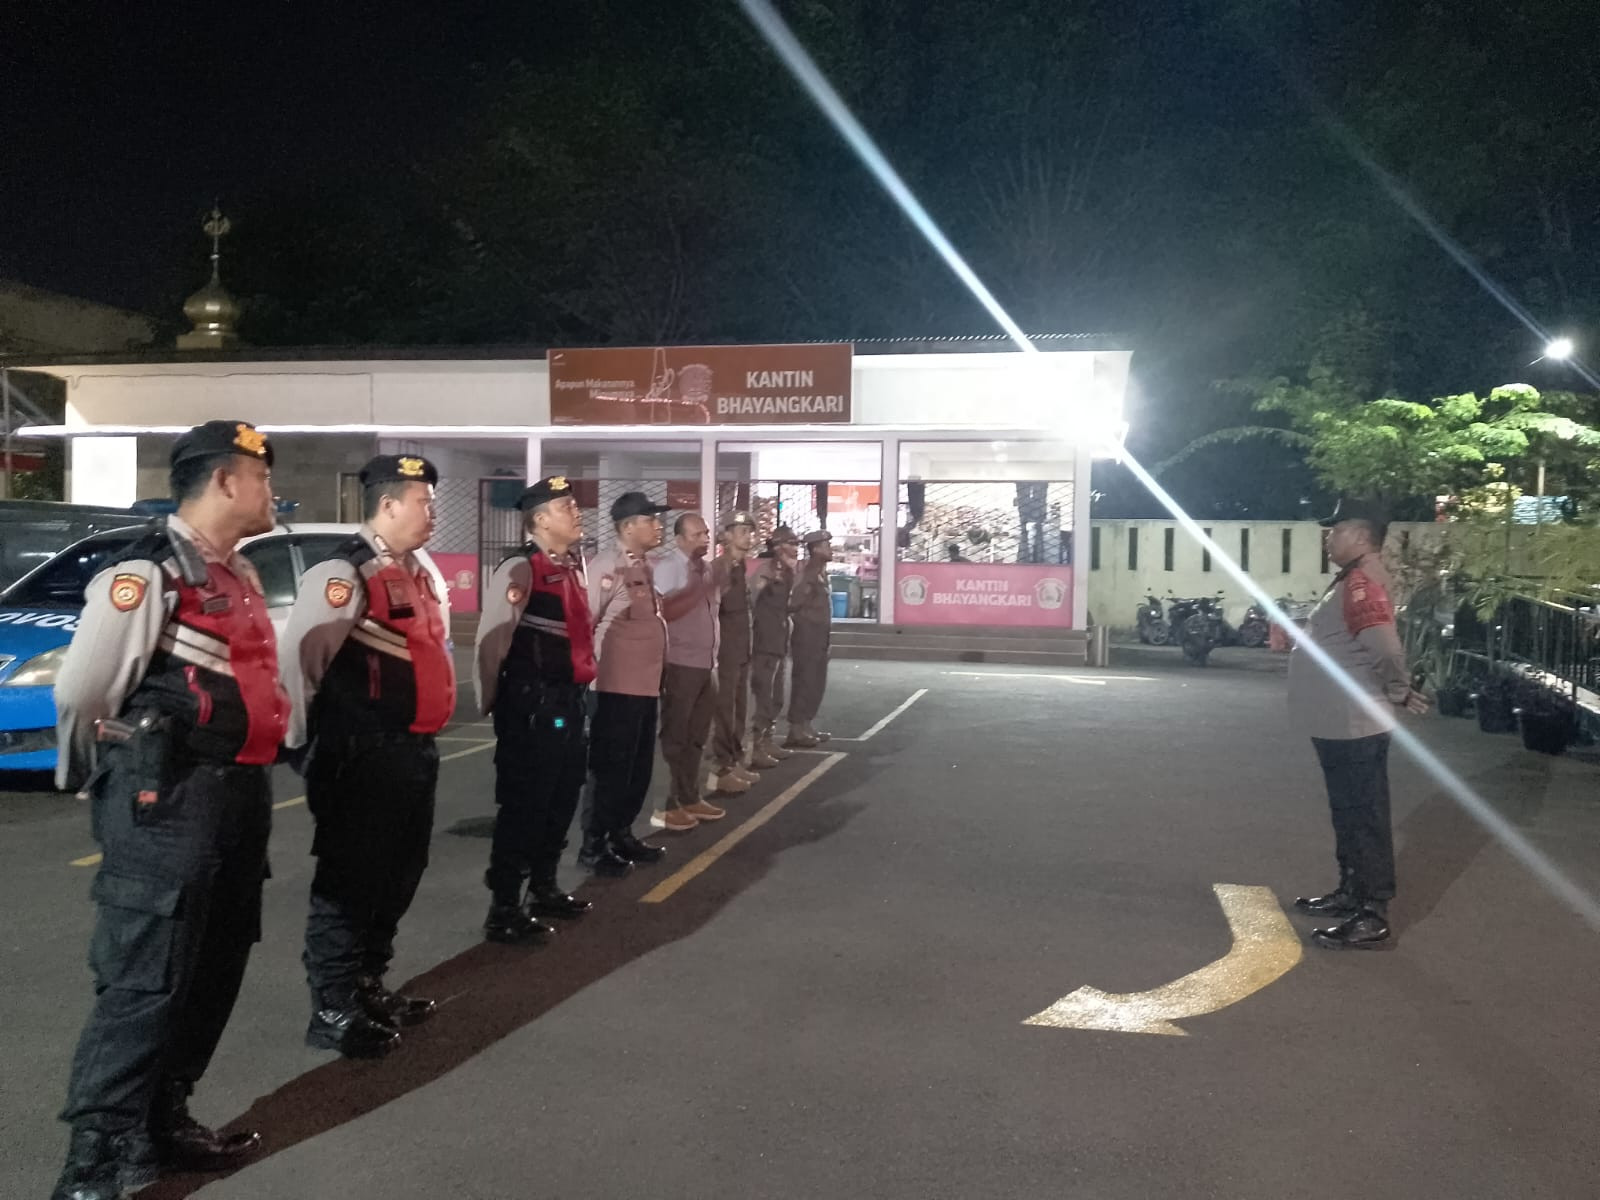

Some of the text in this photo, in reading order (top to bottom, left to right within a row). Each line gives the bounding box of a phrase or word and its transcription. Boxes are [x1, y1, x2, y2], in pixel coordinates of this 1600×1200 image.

[746, 370, 814, 389] KANTIN
[716, 395, 844, 415] BHAYANGKARI
[956, 579, 1009, 592] KANTIN
[932, 592, 1032, 607] BHAYANGKARI
